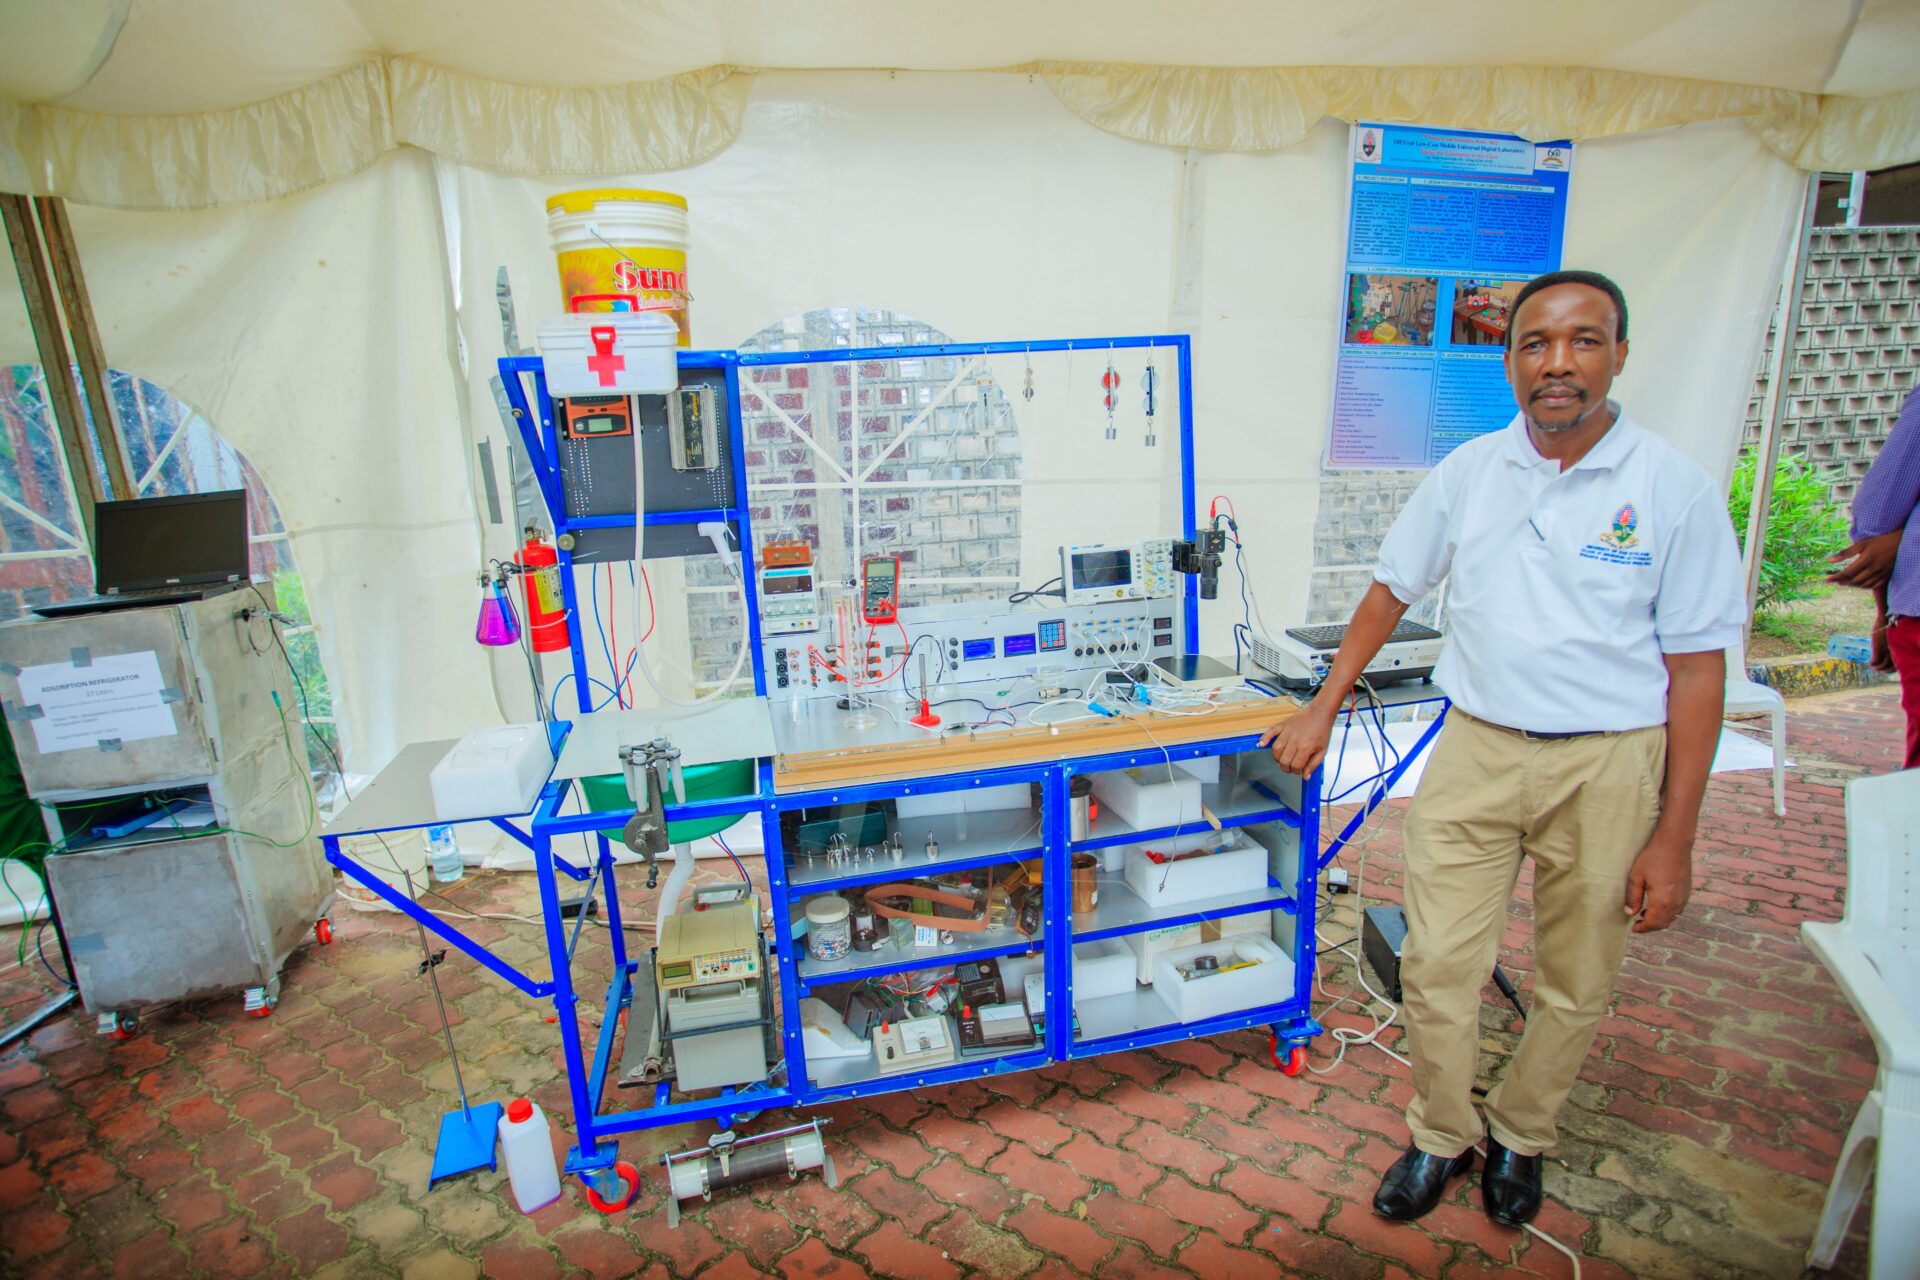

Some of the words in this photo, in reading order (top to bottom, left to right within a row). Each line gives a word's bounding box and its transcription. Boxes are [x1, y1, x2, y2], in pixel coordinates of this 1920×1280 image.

[42, 682, 88, 693] ADSORPTION
[88, 674, 140, 686] REFRIGERATOR
[1161, 927, 1181, 935] Axiom
